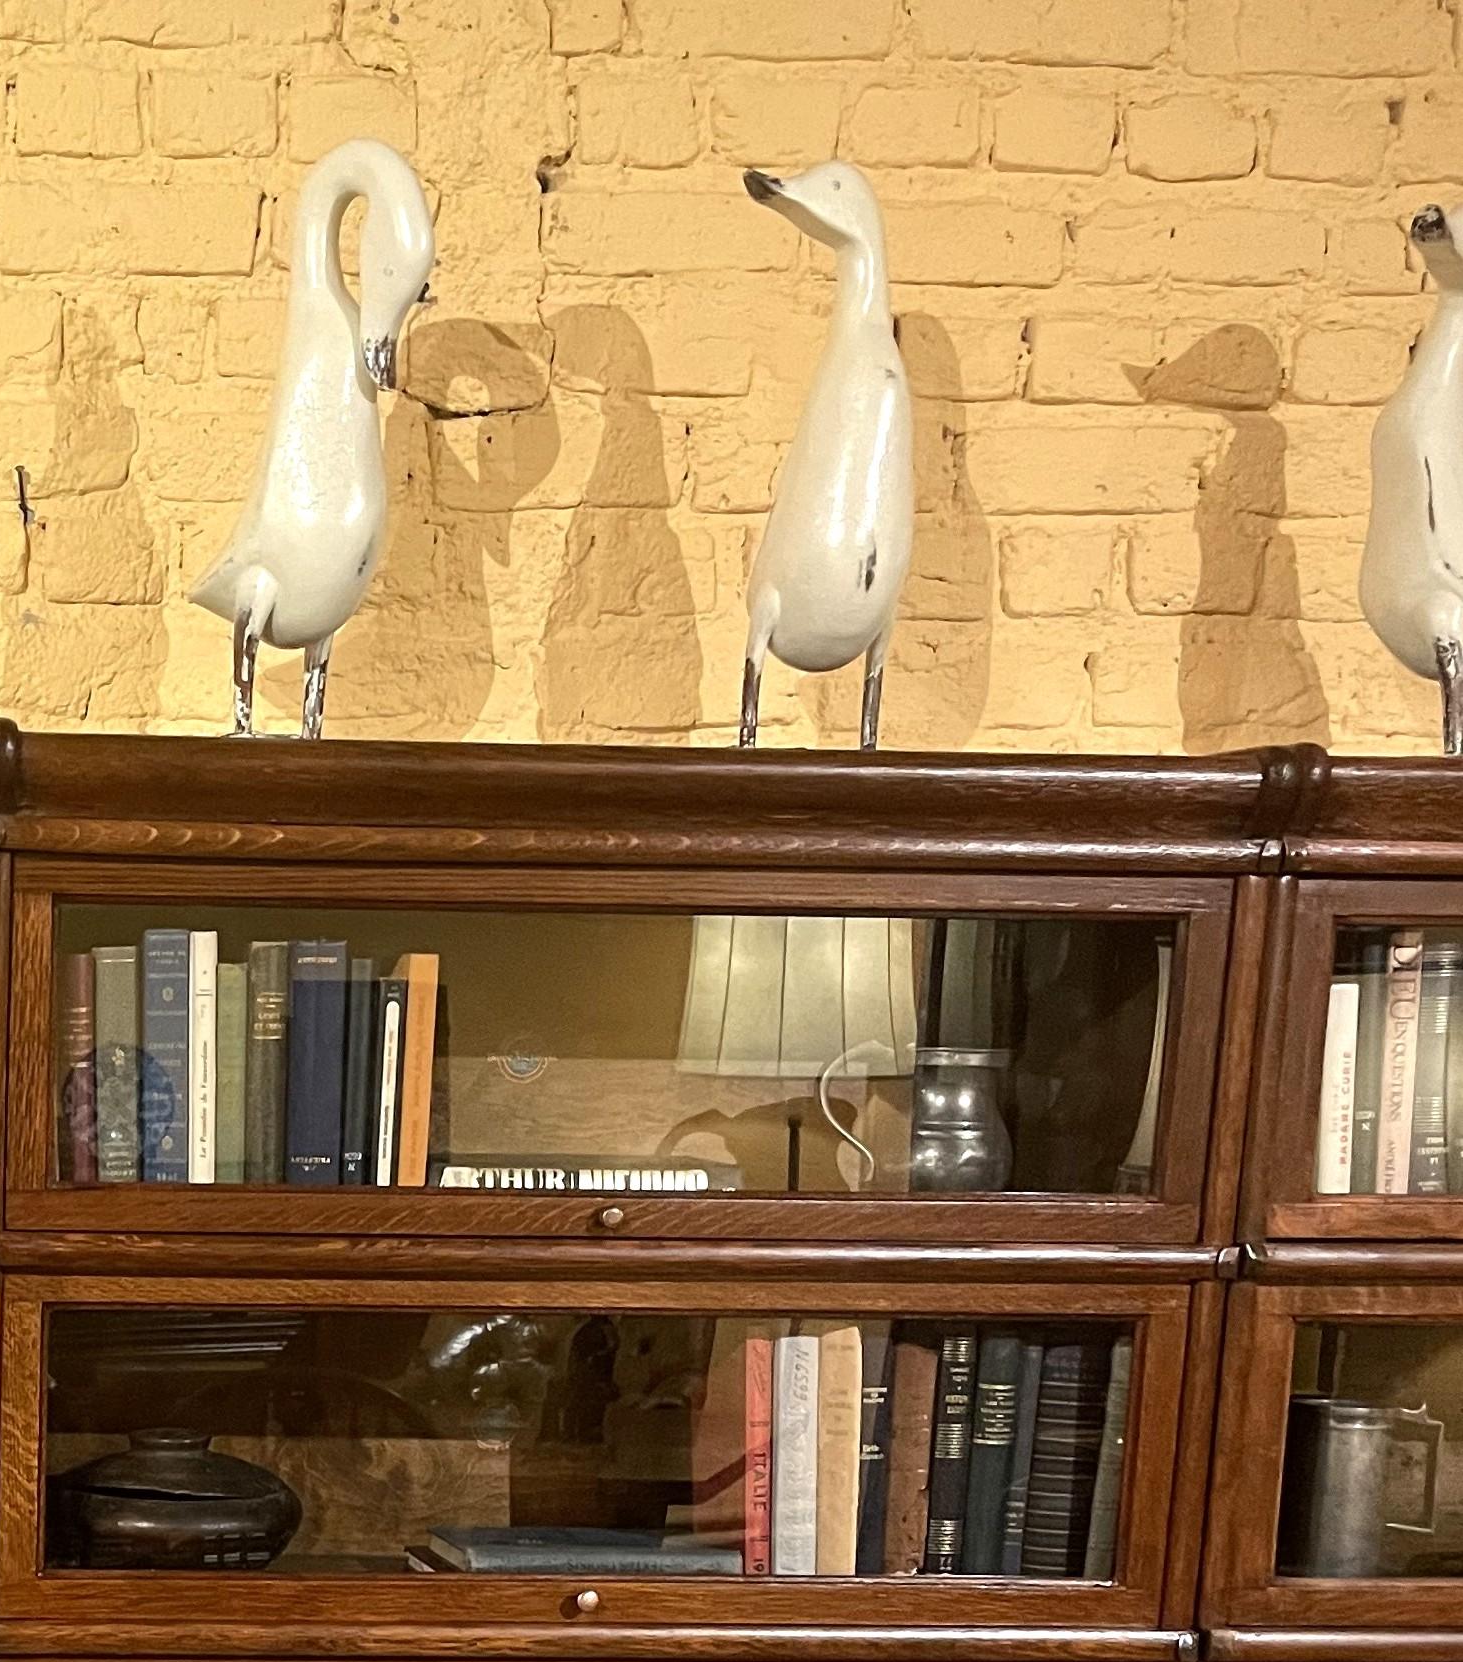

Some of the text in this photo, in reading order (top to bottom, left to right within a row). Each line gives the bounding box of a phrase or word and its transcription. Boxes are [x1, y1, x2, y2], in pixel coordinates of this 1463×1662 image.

[1389, 945, 1422, 1021] DIEU
[1339, 1051, 1352, 1165] MADAME CURIE
[1387, 1043, 1406, 1122] QUESTIONS
[753, 1451, 767, 1572] ITALIE 19
